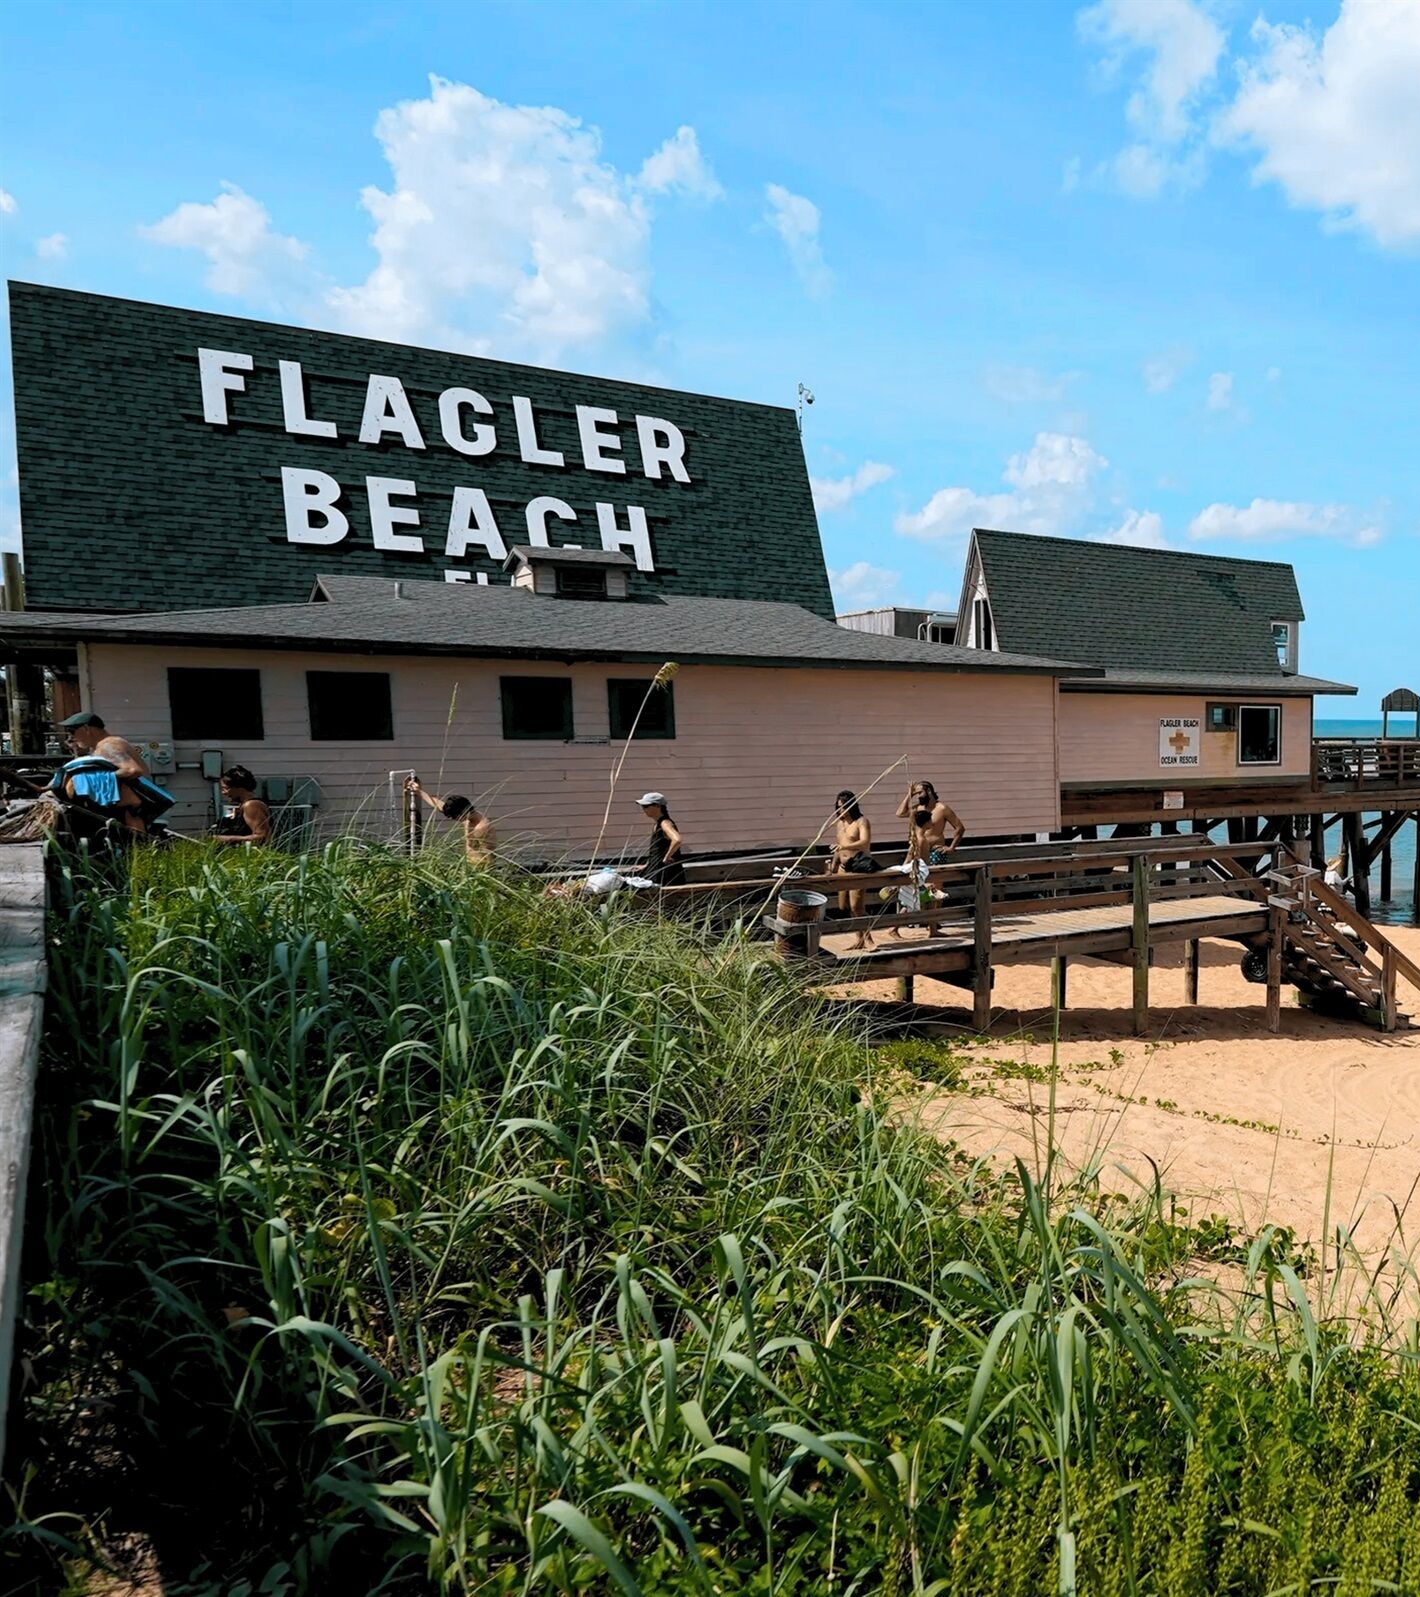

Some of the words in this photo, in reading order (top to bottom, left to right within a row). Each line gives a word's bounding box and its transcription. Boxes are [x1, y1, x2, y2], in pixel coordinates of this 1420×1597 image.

[198, 348, 692, 483] FLAGLER
[281, 466, 655, 572] BEACH
[1160, 719, 1181, 727] FLAGLER
[1183, 719, 1199, 727] BEACH
[1161, 756, 1177, 764] OCEAN
[1179, 755, 1198, 764] RESCUE
